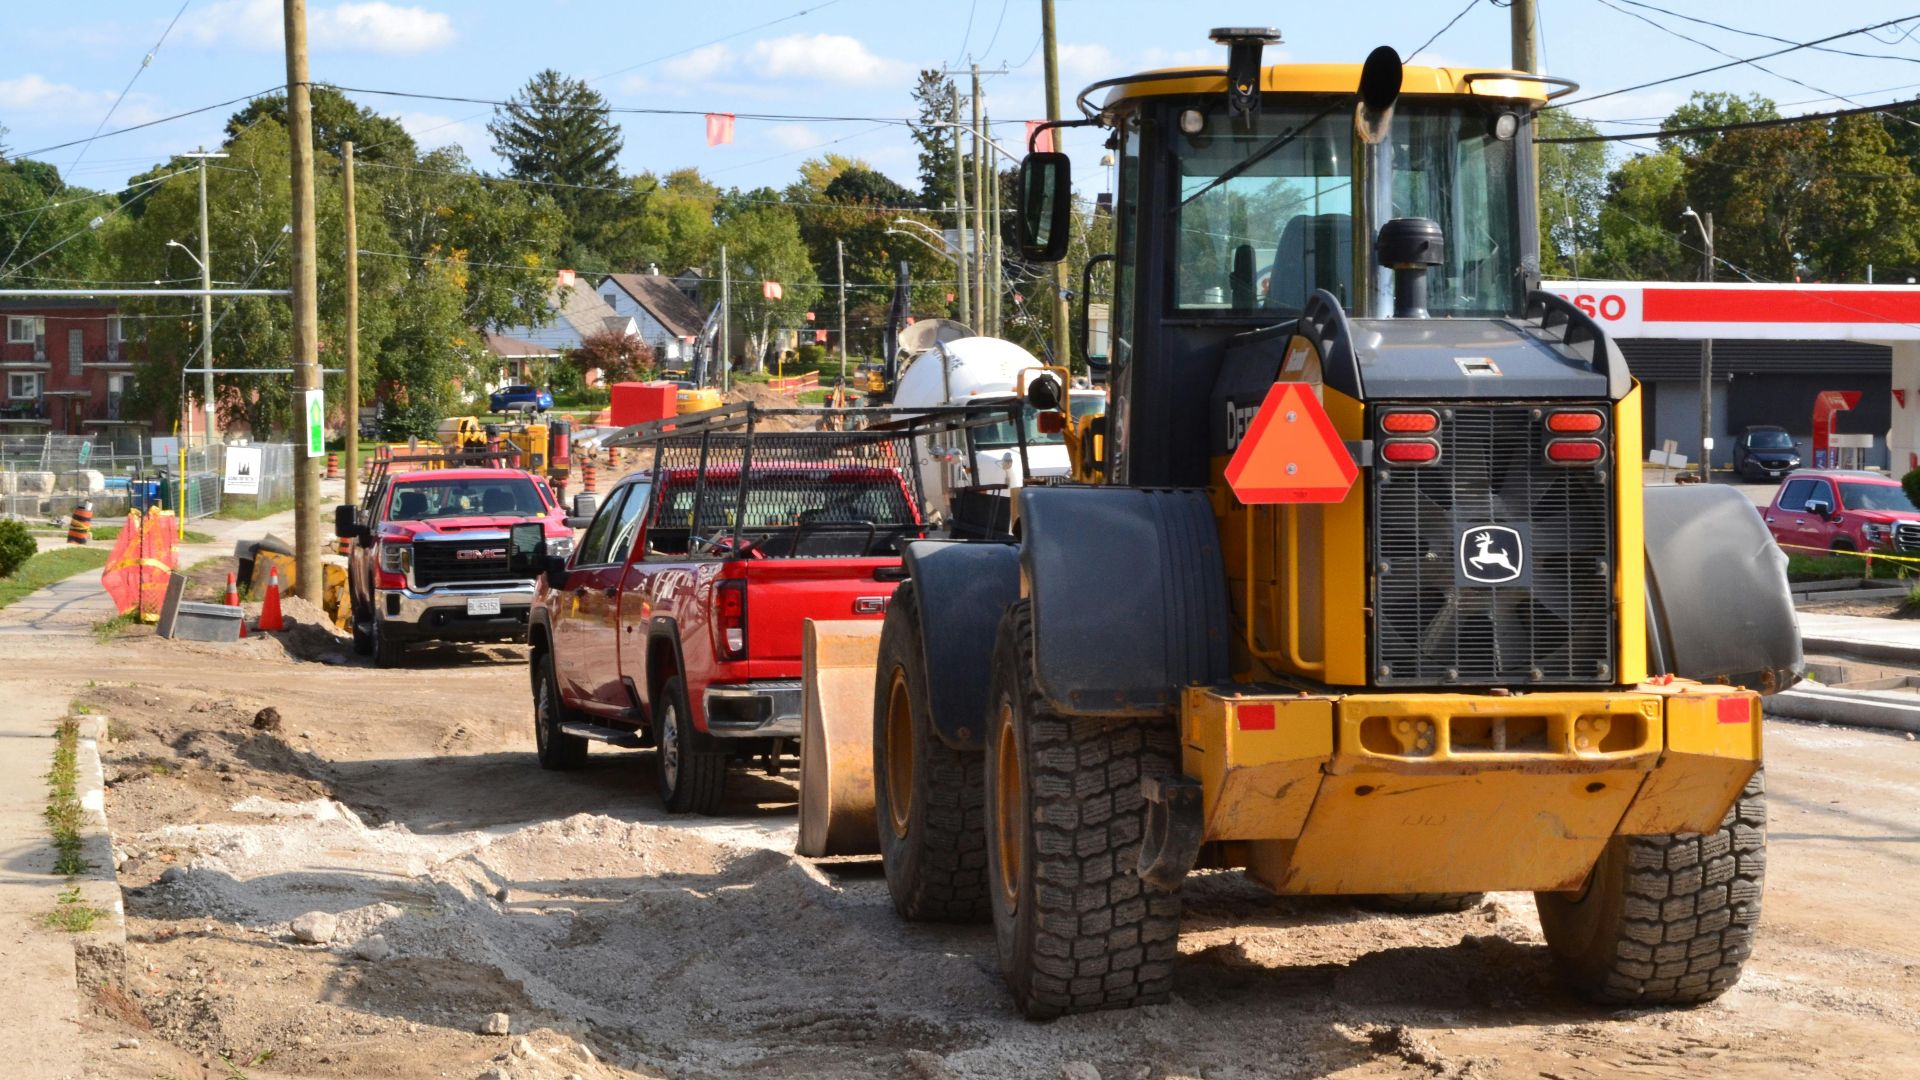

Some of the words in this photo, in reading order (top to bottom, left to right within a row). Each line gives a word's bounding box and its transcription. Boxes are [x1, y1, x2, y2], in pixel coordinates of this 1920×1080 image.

[1558, 294, 1627, 321] SO
[1226, 401, 1260, 450] DEE
[457, 548, 506, 560] GMC
